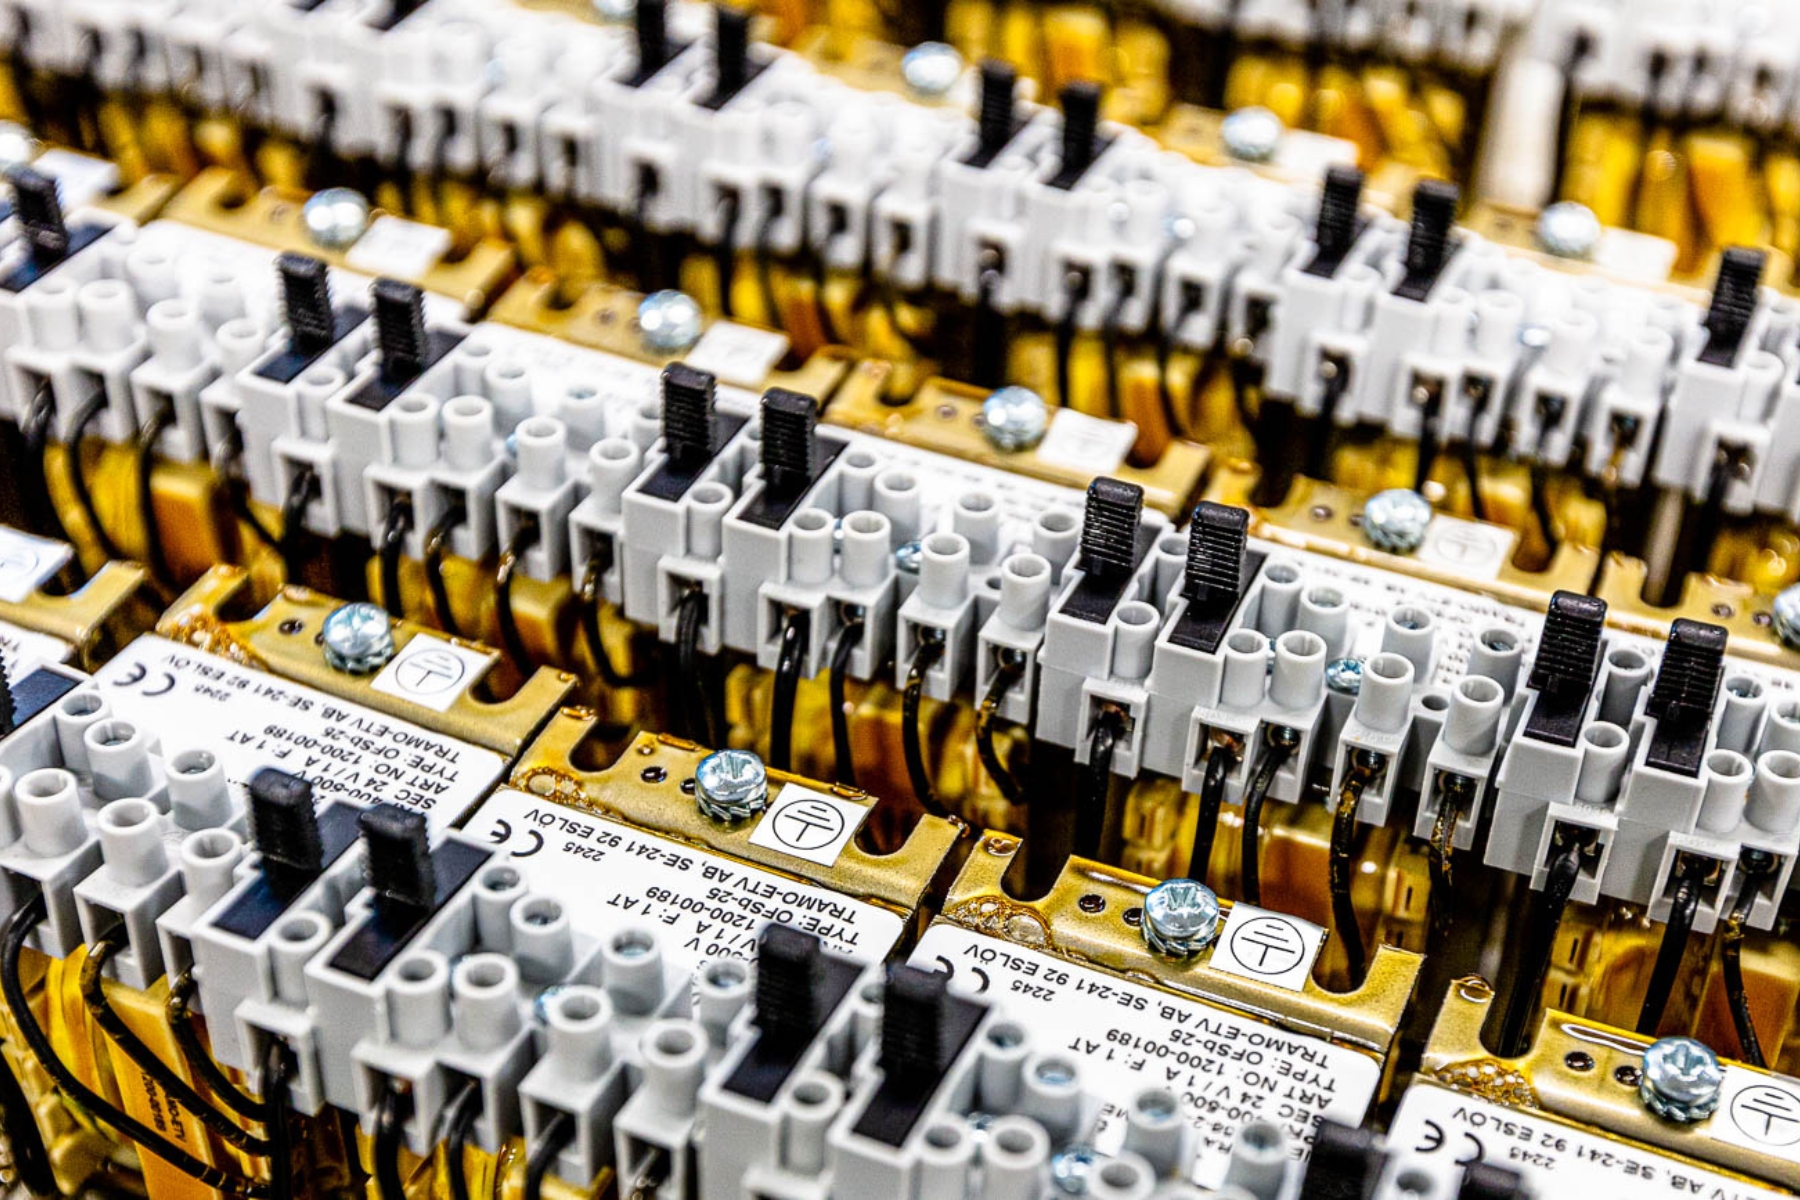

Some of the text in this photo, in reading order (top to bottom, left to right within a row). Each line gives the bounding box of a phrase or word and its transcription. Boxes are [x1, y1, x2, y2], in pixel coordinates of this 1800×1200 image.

[112, 661, 176, 697] CE
[253, 685, 315, 712] SE-241
[225, 731, 256, 745] AT
[255, 740, 267, 751] 1
[349, 716, 461, 764] TRAMO-ETV
[263, 724, 451, 796] ART NO: 1200-00189
[305, 756, 321, 768] A
[322, 762, 332, 774] 1
[403, 754, 460, 782] TYPE:
[349, 772, 362, 784] V
[363, 778, 389, 793] 24
[394, 788, 438, 811] SEC
[489, 819, 545, 858] CE
[562, 841, 606, 862] 2245
[523, 808, 857, 925] TRAMO-ETV AB, SE-241 92 ESLÖV
[606, 893, 640, 910] AT
[641, 903, 652, 916] 1
[646, 886, 755, 931] 1200-00189
[658, 908, 681, 926] F:
[706, 887, 859, 945] TYPE: OFSb-25
[696, 921, 712, 934] A
[715, 928, 724, 940] 1
[728, 933, 742, 945] /
[1010, 979, 1056, 1002] 2245
[963, 944, 1329, 1069] TRAMO-ETV AB, SE-241 92 ESLÖV
[1068, 1037, 1101, 1055] AT
[1105, 1048, 1116, 1061] 1
[1106, 1028, 1334, 1110] ART NO: 1200-00189
[1124, 1053, 1147, 1072] F:
[1169, 1029, 1337, 1093] TYPE: OFSb-25
[1165, 1066, 1181, 1080] A
[1187, 1075, 1196, 1087] 1
[1218, 1085, 1231, 1099] V
[1240, 1092, 1265, 1109] 24
[1277, 1103, 1326, 1127] SEC
[1415, 1119, 1485, 1167] CE
[1540, 1133, 1568, 1151] 92
[1576, 1144, 1657, 1181] SE-241
